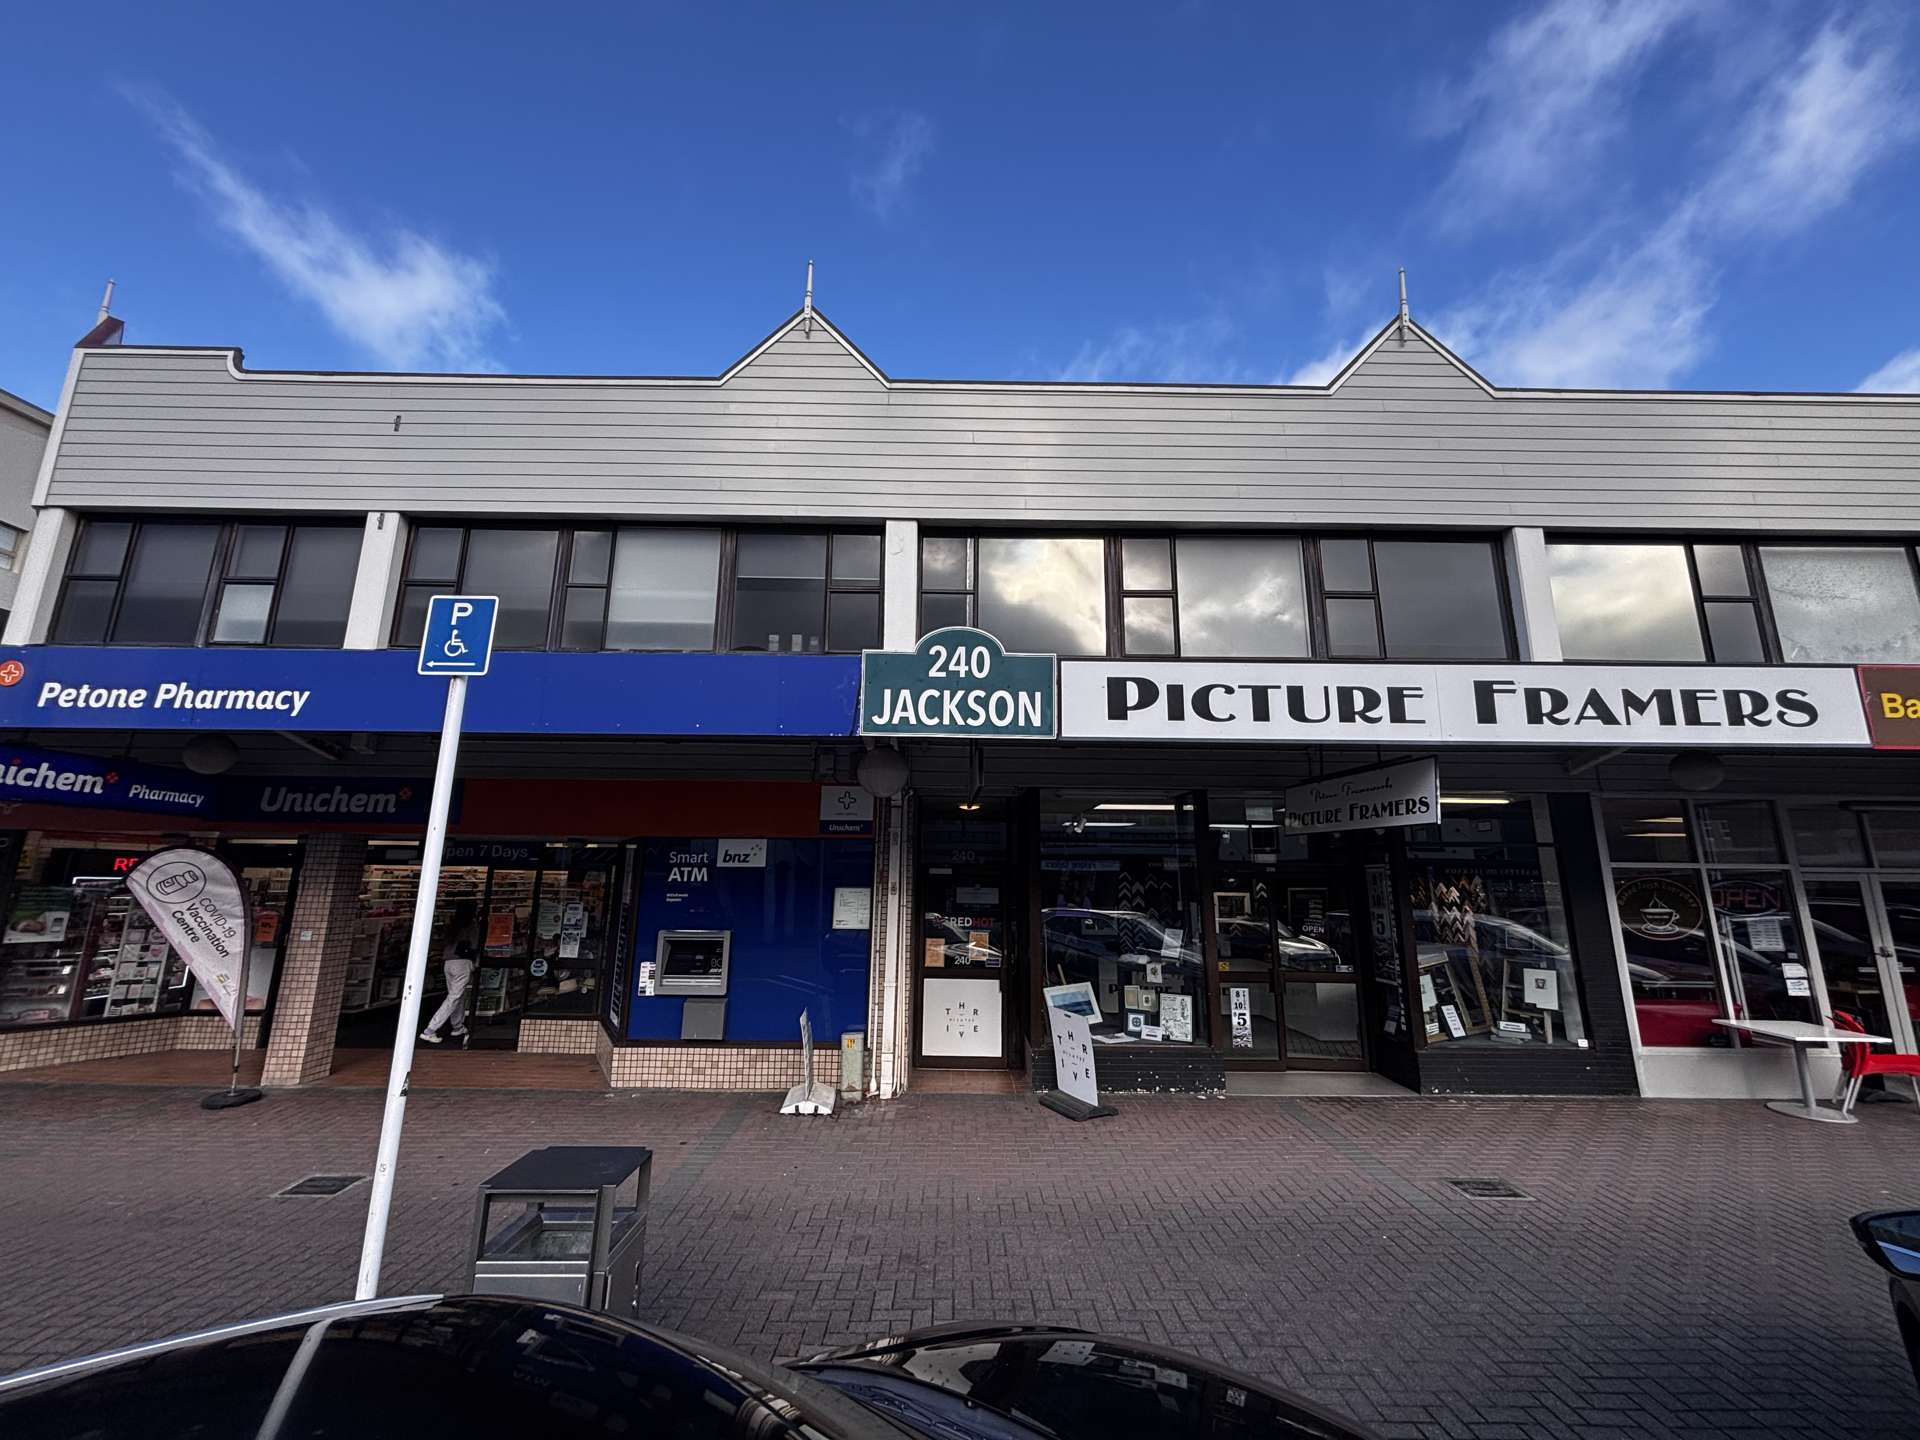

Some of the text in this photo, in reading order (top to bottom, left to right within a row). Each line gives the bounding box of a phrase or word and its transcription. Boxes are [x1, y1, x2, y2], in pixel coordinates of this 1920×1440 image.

[451, 602, 473, 626] P
[927, 645, 991, 679] 240
[37, 682, 311, 717] Petone Pharmacy
[871, 688, 1042, 728] JACKSON
[1107, 676, 1819, 728] PICTURE FRAMERS
[0, 758, 205, 808] ichem Pharmacy
[260, 786, 397, 814] Unichem
[1349, 796, 1430, 822] FRAMERS
[443, 844, 529, 861] pen 7 Days
[668, 851, 709, 864] Smart
[722, 849, 752, 864] bnz
[667, 866, 709, 882] ATM
[171, 910, 201, 944] Centre
[186, 902, 231, 959] Vaccination
[198, 897, 237, 939] COVID-19
[1301, 924, 1325, 935] OPEN
[953, 955, 972, 966] 240
[1234, 1001, 1243, 1010] 10
